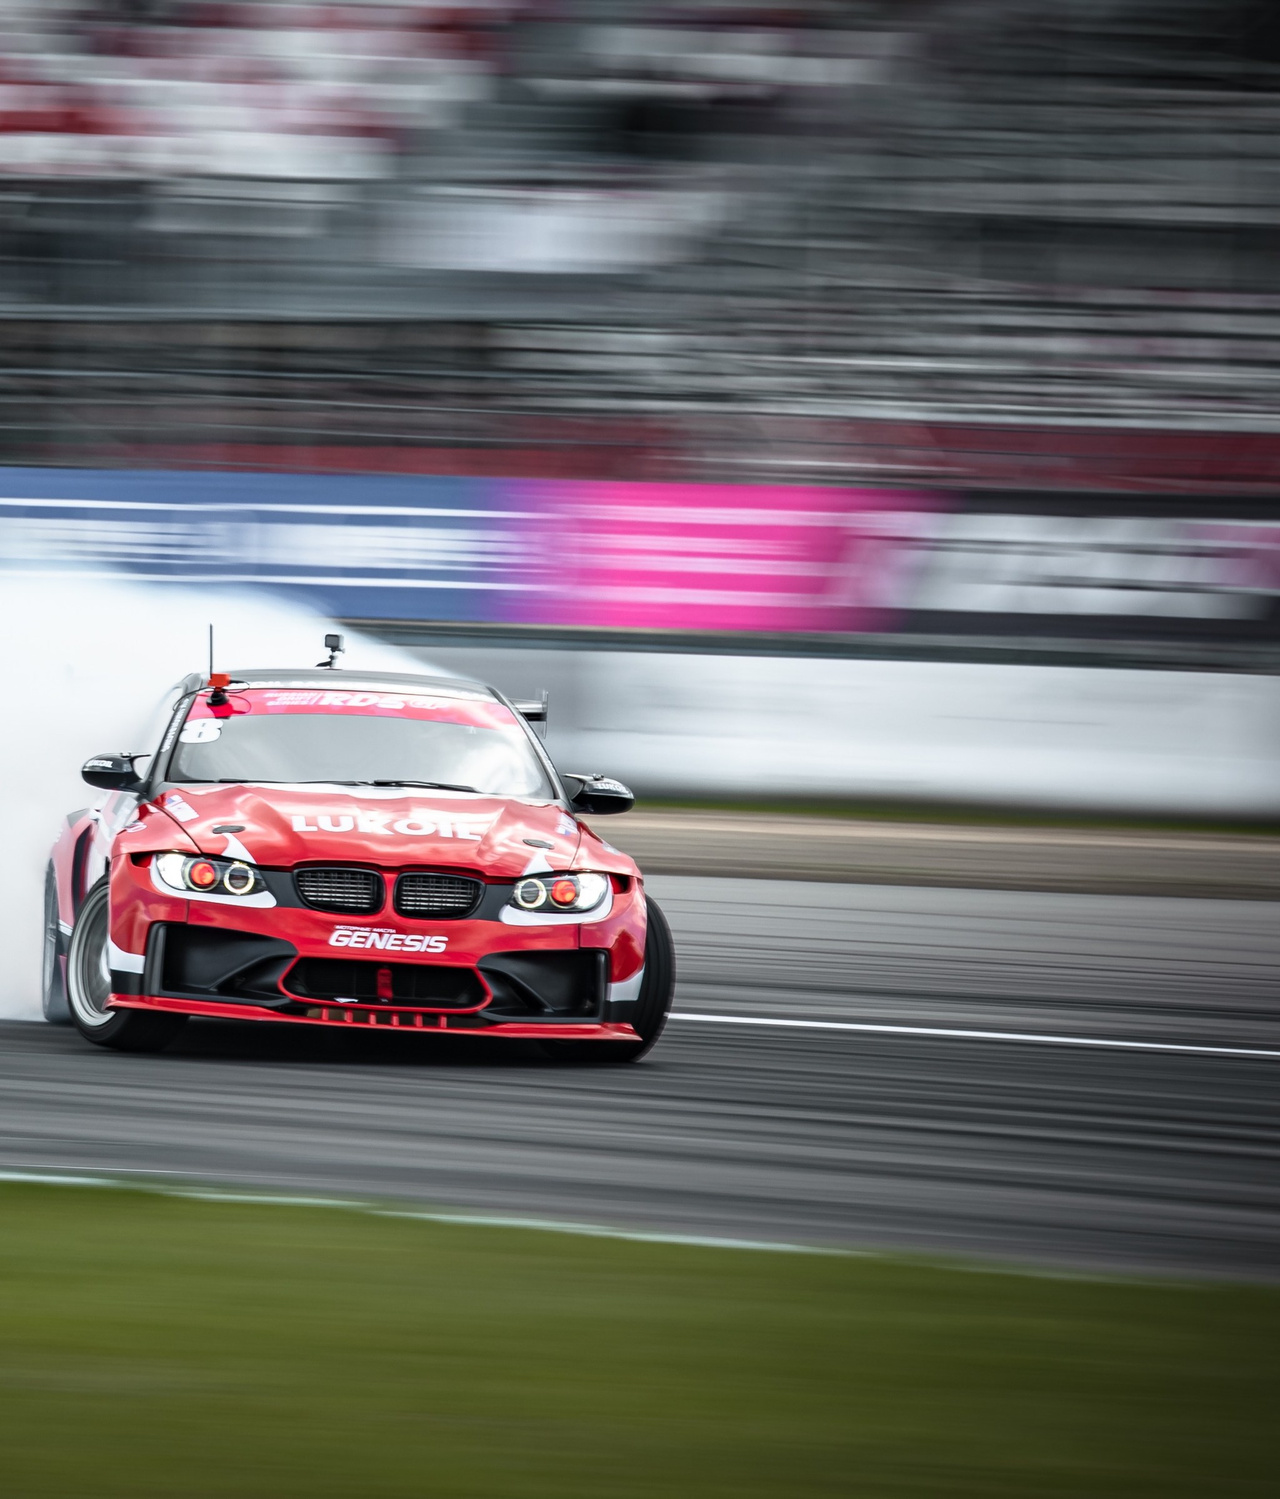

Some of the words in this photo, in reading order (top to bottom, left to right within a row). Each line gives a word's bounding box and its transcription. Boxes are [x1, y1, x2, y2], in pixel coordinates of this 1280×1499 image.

[319, 692, 405, 709] RDS
[179, 718, 224, 744] 8
[291, 814, 483, 841] LUKOIL
[328, 930, 448, 953] GENESIS
